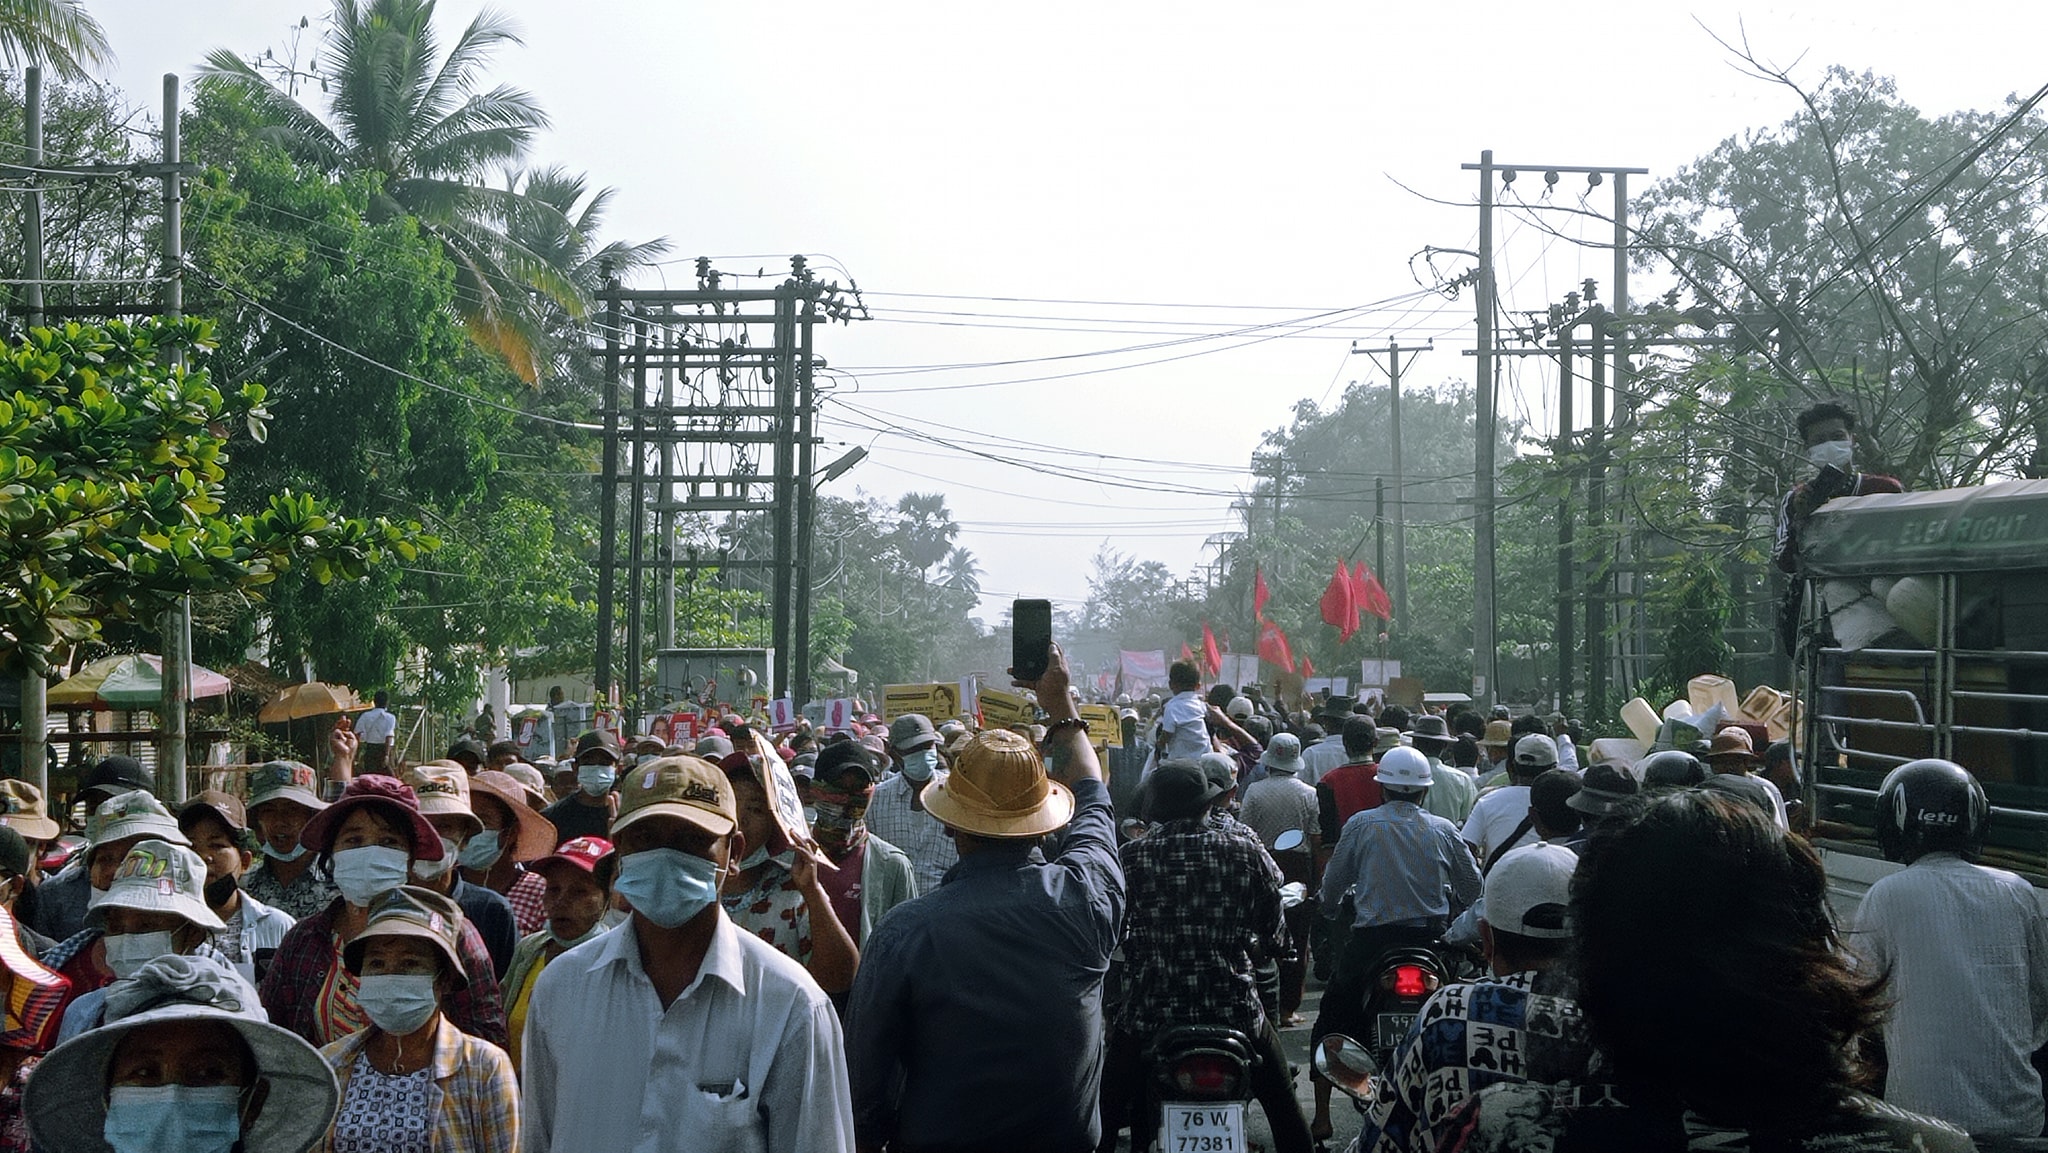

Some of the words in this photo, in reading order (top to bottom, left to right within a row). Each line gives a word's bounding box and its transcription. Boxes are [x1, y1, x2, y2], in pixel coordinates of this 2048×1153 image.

[1181, 1112, 1204, 1127] 76
[1210, 1112, 1228, 1126] W
[1177, 1136, 1233, 1152] 77381
